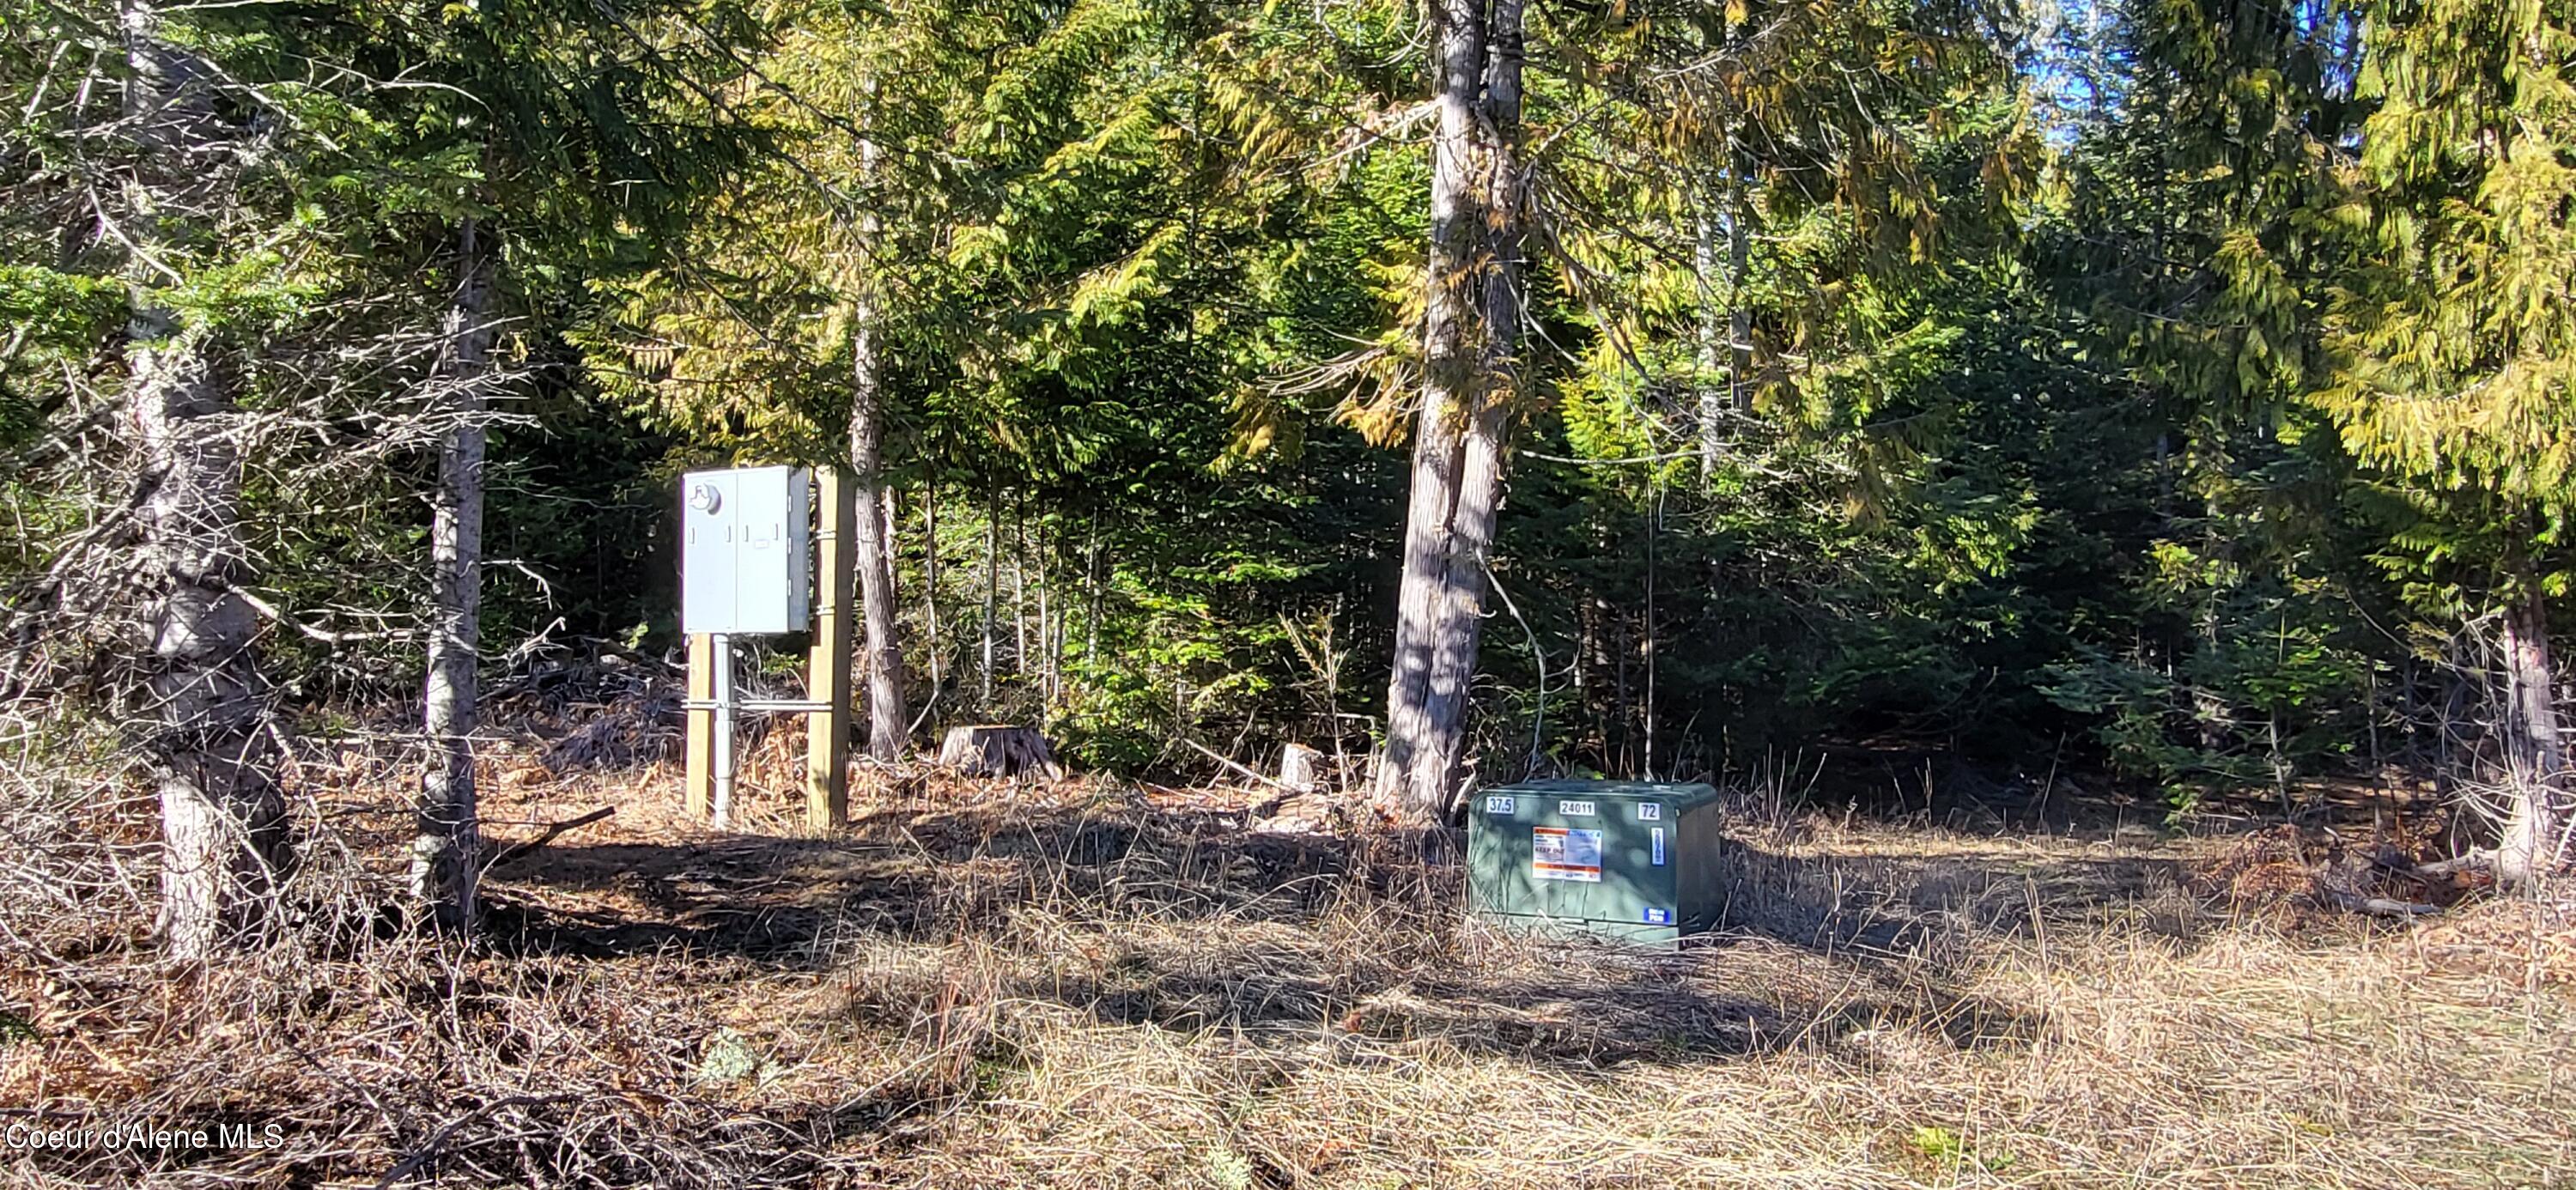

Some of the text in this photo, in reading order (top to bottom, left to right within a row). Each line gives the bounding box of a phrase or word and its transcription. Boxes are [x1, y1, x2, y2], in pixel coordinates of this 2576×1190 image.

[1490, 798, 1511, 812] 37.5
[1562, 803, 1592, 813] 24011
[1642, 804, 1656, 818] 72
